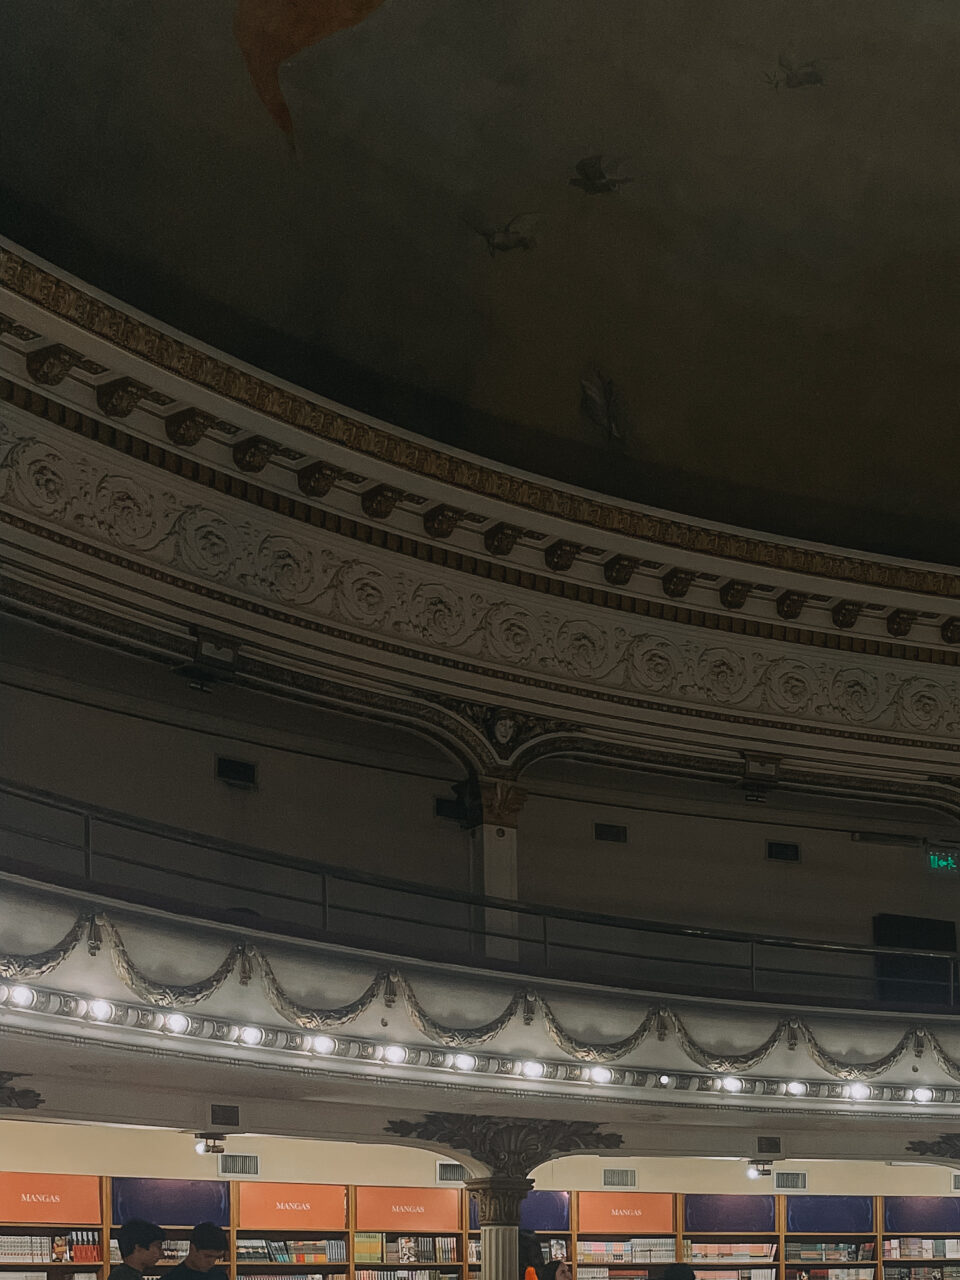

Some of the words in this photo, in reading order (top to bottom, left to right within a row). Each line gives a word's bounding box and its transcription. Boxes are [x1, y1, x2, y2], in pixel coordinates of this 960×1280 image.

[20, 1193, 61, 1203] MANGAS
[275, 1201, 311, 1211] MANGAS
[391, 1205, 425, 1213] MANGAS
[611, 1208, 642, 1216] MANGAS
